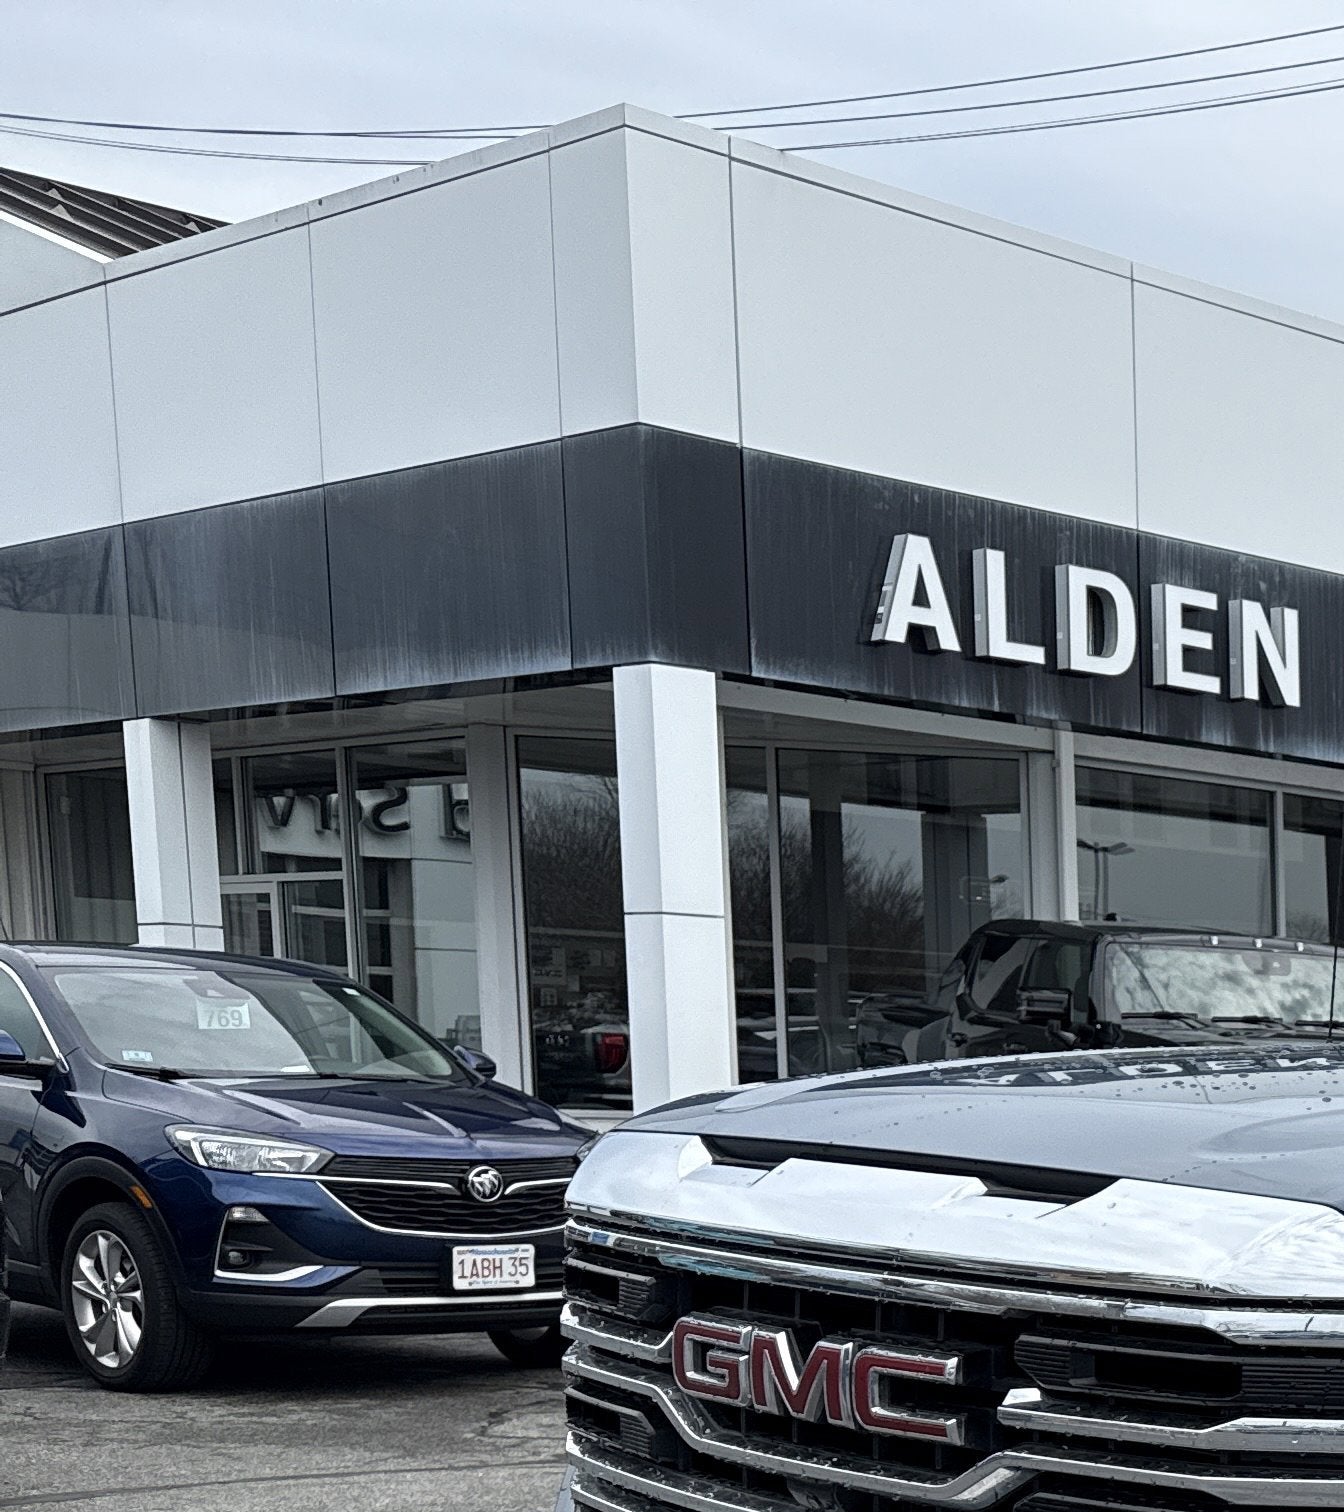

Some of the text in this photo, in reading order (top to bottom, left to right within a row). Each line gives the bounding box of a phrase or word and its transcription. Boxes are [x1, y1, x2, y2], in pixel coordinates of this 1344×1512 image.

[870, 532, 1300, 708] ALDEN
[206, 1009, 243, 1027] 769
[458, 1256, 530, 1279] 1ABH 35
[672, 1314, 967, 1447] GMC
